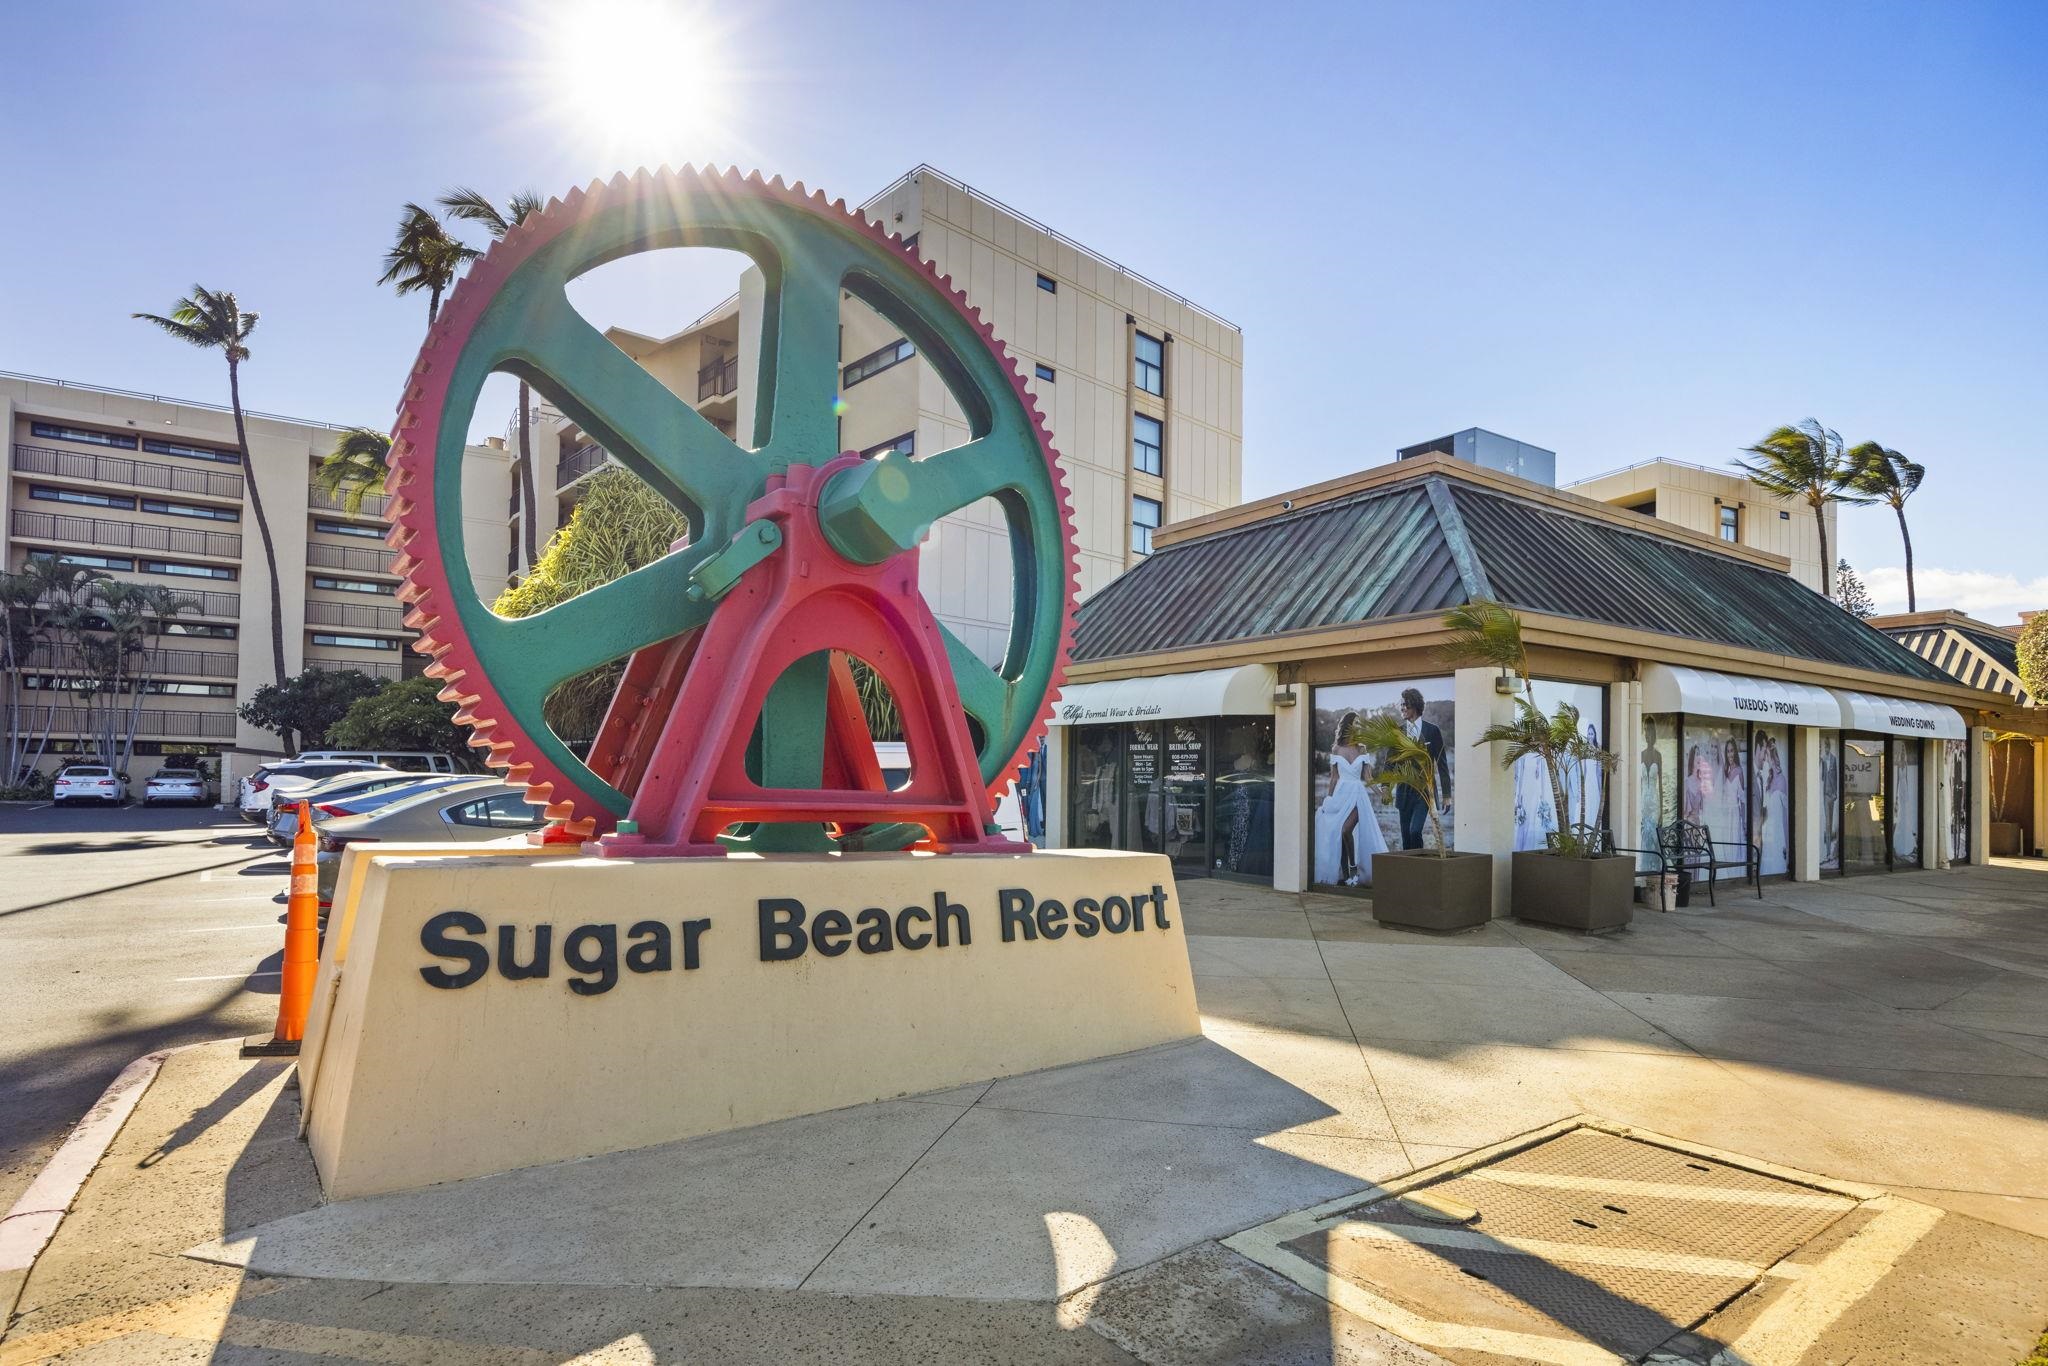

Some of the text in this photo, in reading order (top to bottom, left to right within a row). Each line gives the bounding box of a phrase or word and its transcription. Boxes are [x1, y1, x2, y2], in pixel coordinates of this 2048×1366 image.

[1085, 708, 1108, 719] Formal
[1110, 707, 1127, 717] Wear
[1128, 707, 1133, 716] &
[1135, 704, 1161, 716] Bridals
[1733, 697, 1768, 712] TUXEDOS
[1774, 701, 1799, 715] PROMS
[1889, 715, 1935, 730] WEDDING GOWNS
[419, 885, 1171, 996] Sugar Beach Resort
